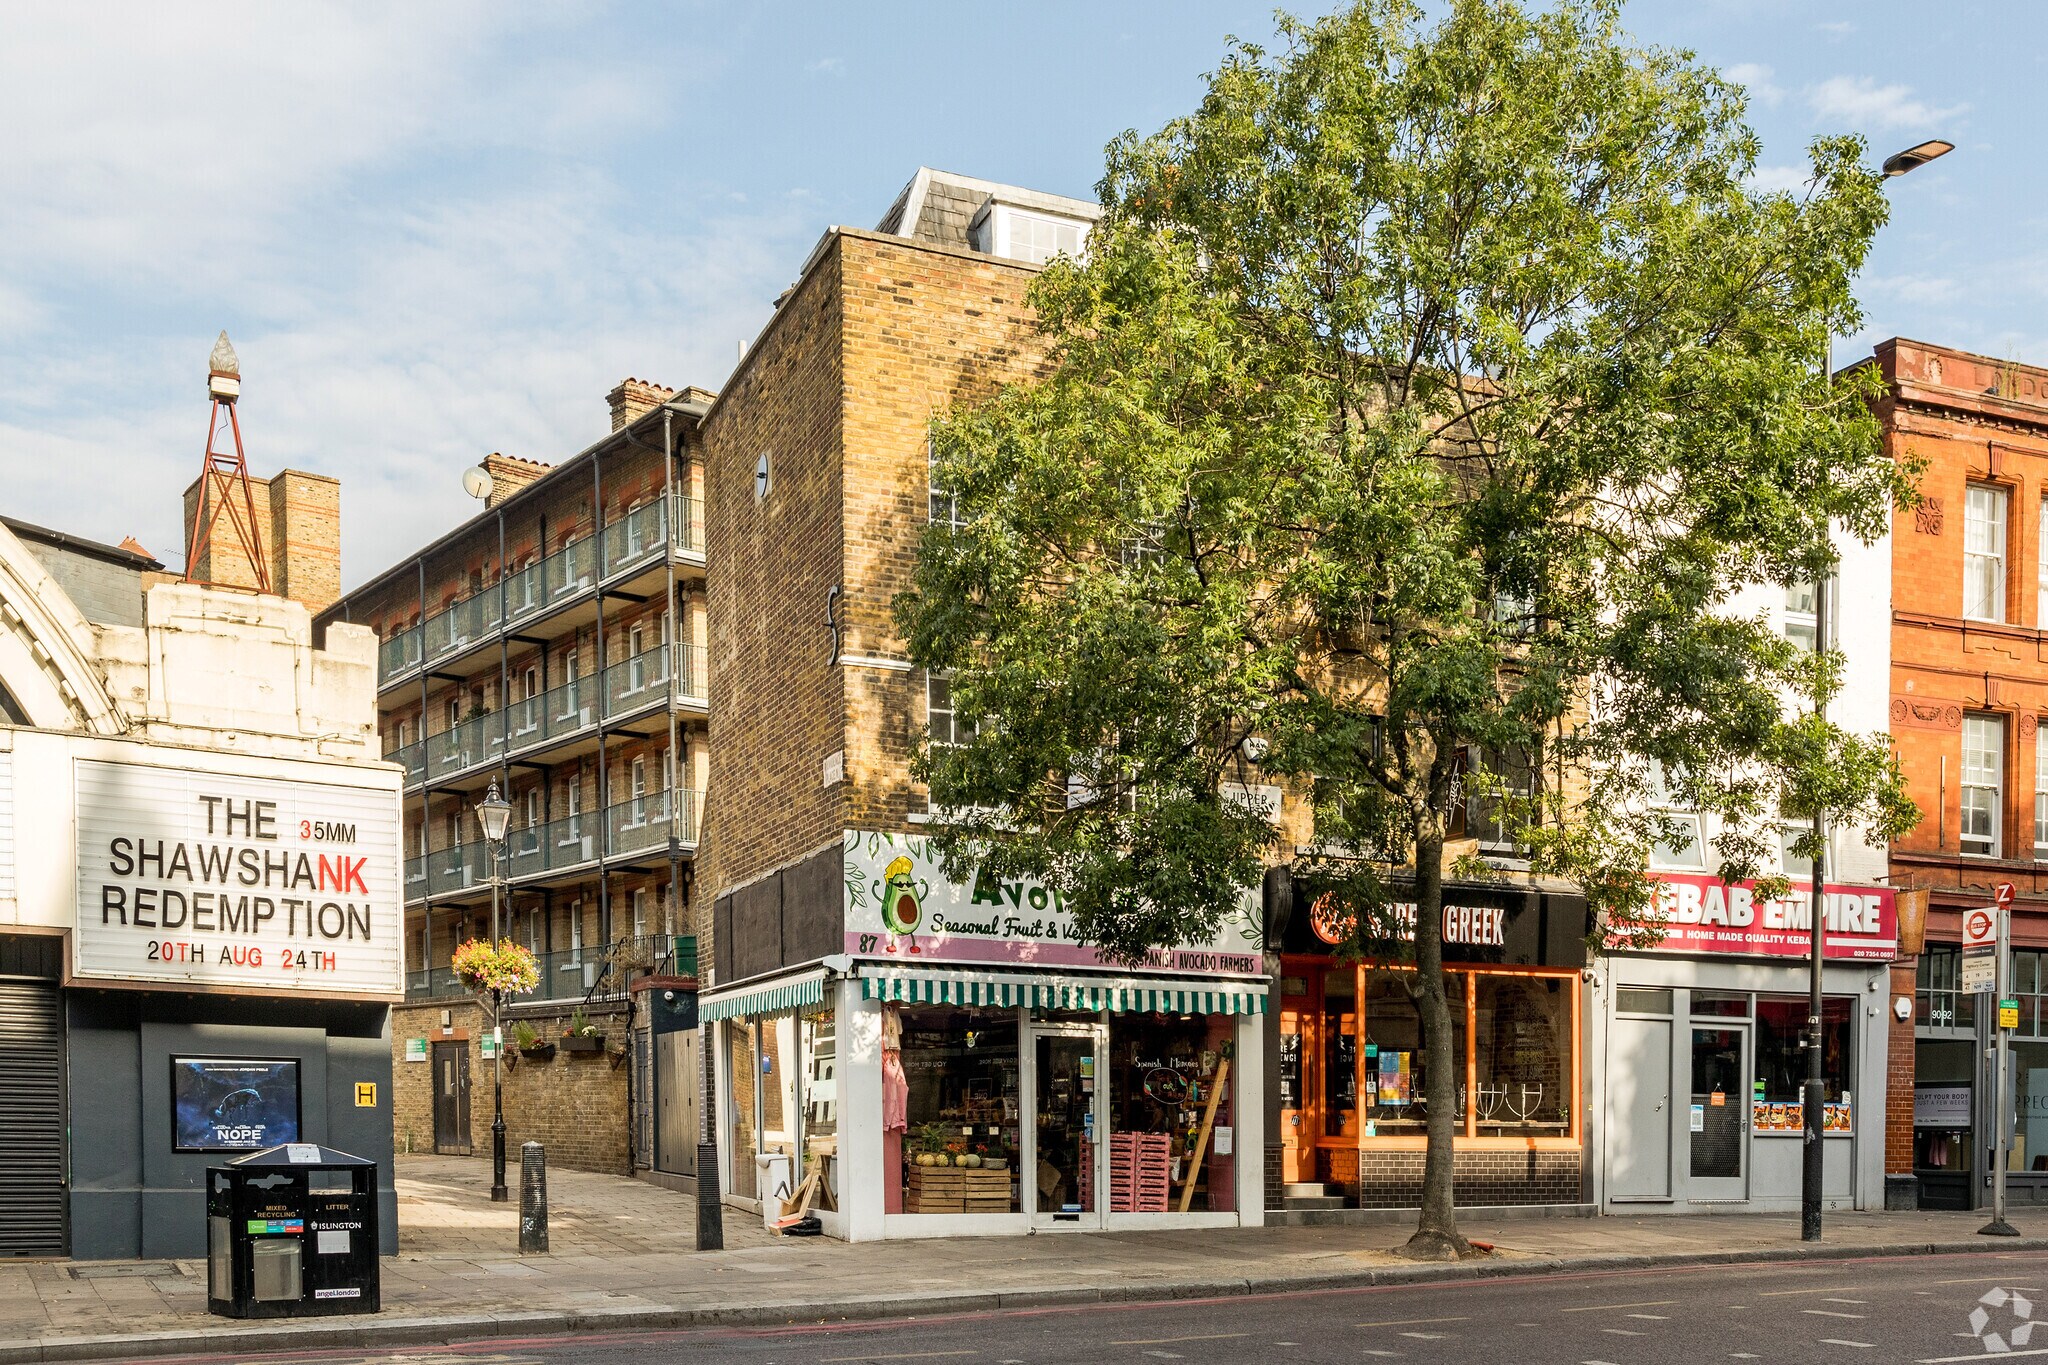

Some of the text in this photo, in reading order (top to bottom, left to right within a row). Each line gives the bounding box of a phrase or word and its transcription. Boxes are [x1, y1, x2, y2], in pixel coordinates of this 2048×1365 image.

[1232, 791, 1267, 805] UPPER
[199, 795, 278, 840] THE
[300, 820, 356, 843] 35MM
[109, 837, 369, 894] SHAWSHANK
[1998, 884, 2010, 902] Z
[102, 885, 371, 941] REDEMPTION
[930, 913, 999, 936] Seasonal
[1003, 917, 1043, 938] Fruit
[1046, 922, 1058, 939] &
[1443, 905, 1504, 944] GREEK
[859, 934, 878, 953] 87
[1687, 930, 1811, 944] HOME MADE QUALITY KEBA
[147, 940, 336, 971] 20TH AUG 24TH
[1140, 951, 1254, 972] SPANISH AVOCADO FARMERS
[1134, 1056, 1199, 1071] Spanish Mangoes
[358, 1085, 373, 1104] H
[217, 1129, 262, 1140] NOPE
[319, 1222, 362, 1230] ISLINGTON
